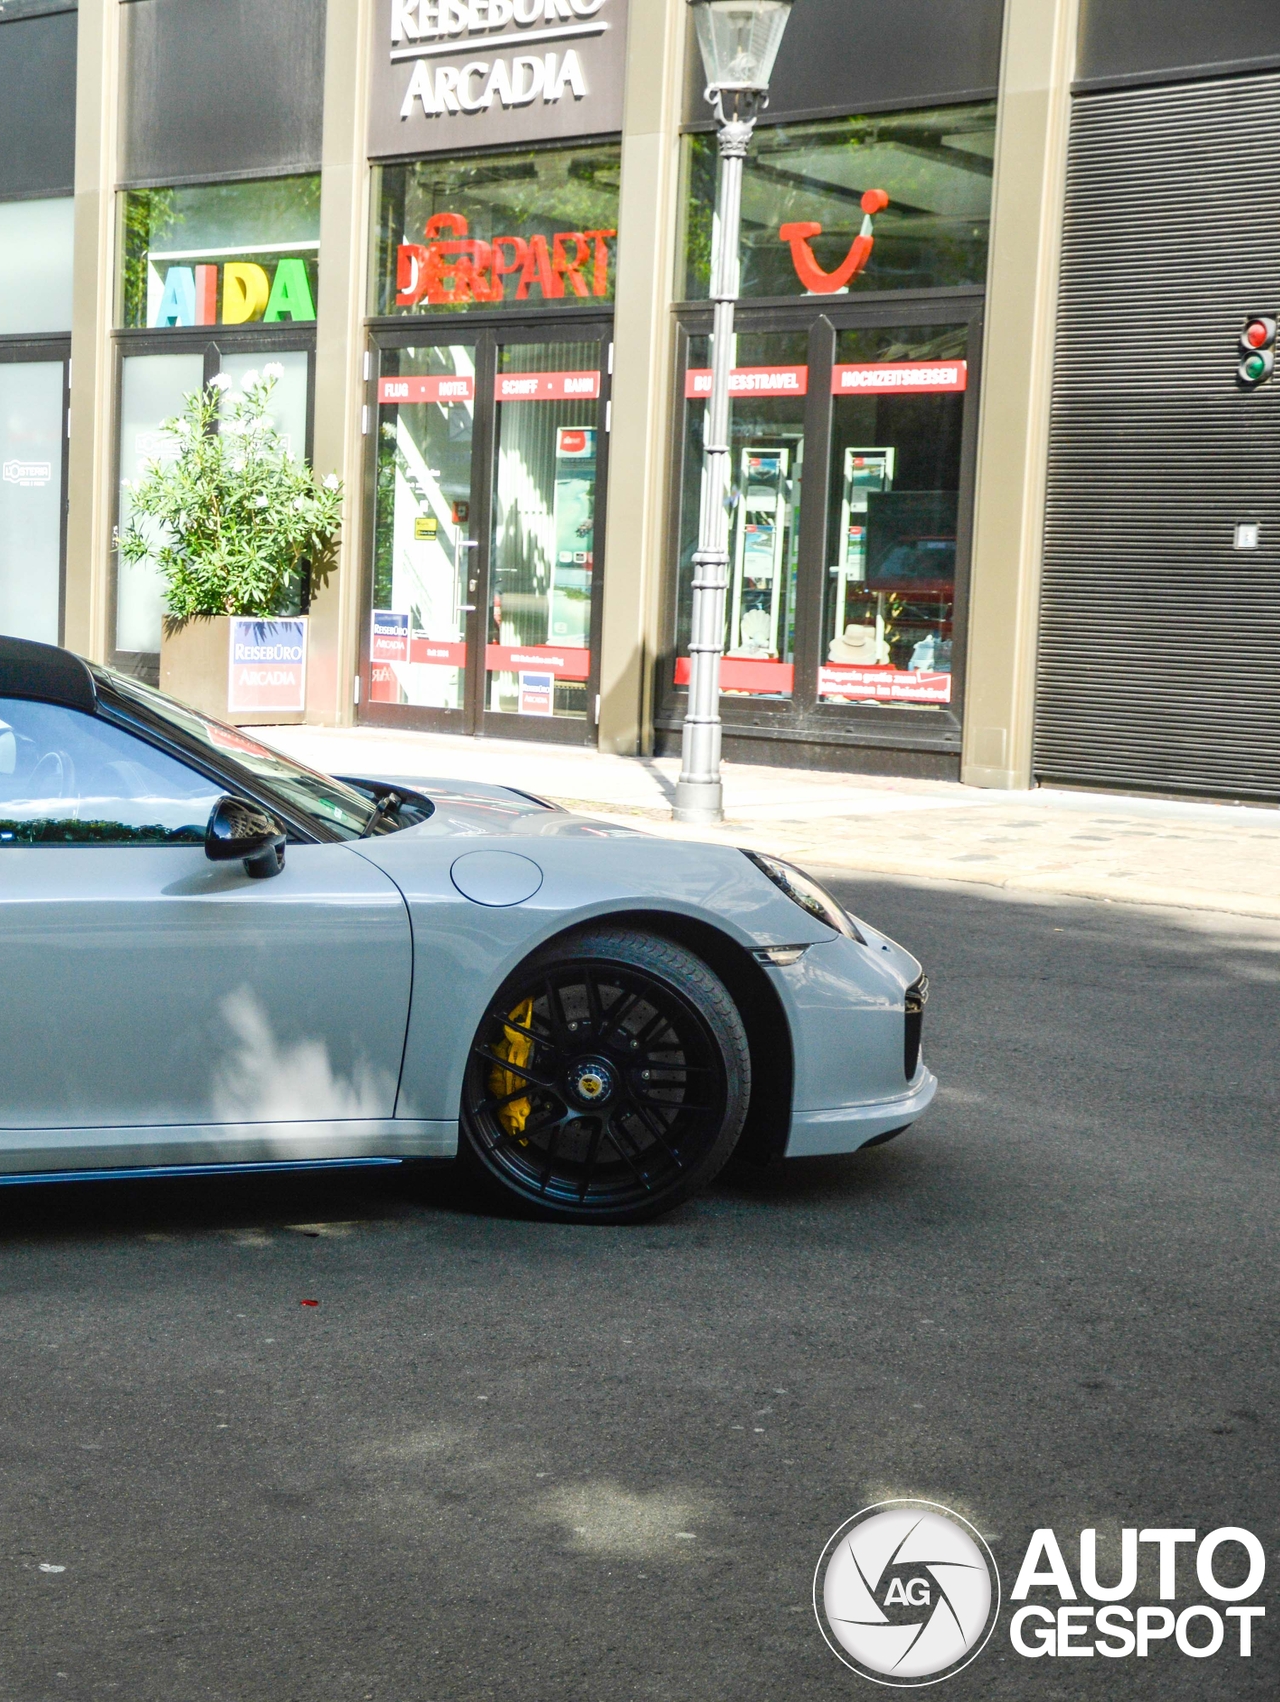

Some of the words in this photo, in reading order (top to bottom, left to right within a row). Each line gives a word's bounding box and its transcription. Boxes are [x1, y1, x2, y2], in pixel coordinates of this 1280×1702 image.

[400, 49, 587, 117] ARCADIA
[396, 229, 618, 306] DERPART
[155, 258, 316, 327] AIDA
[385, 383, 409, 397] FLUG
[235, 643, 302, 660] REISEBÜRO
[240, 669, 295, 686] ARCADIA
